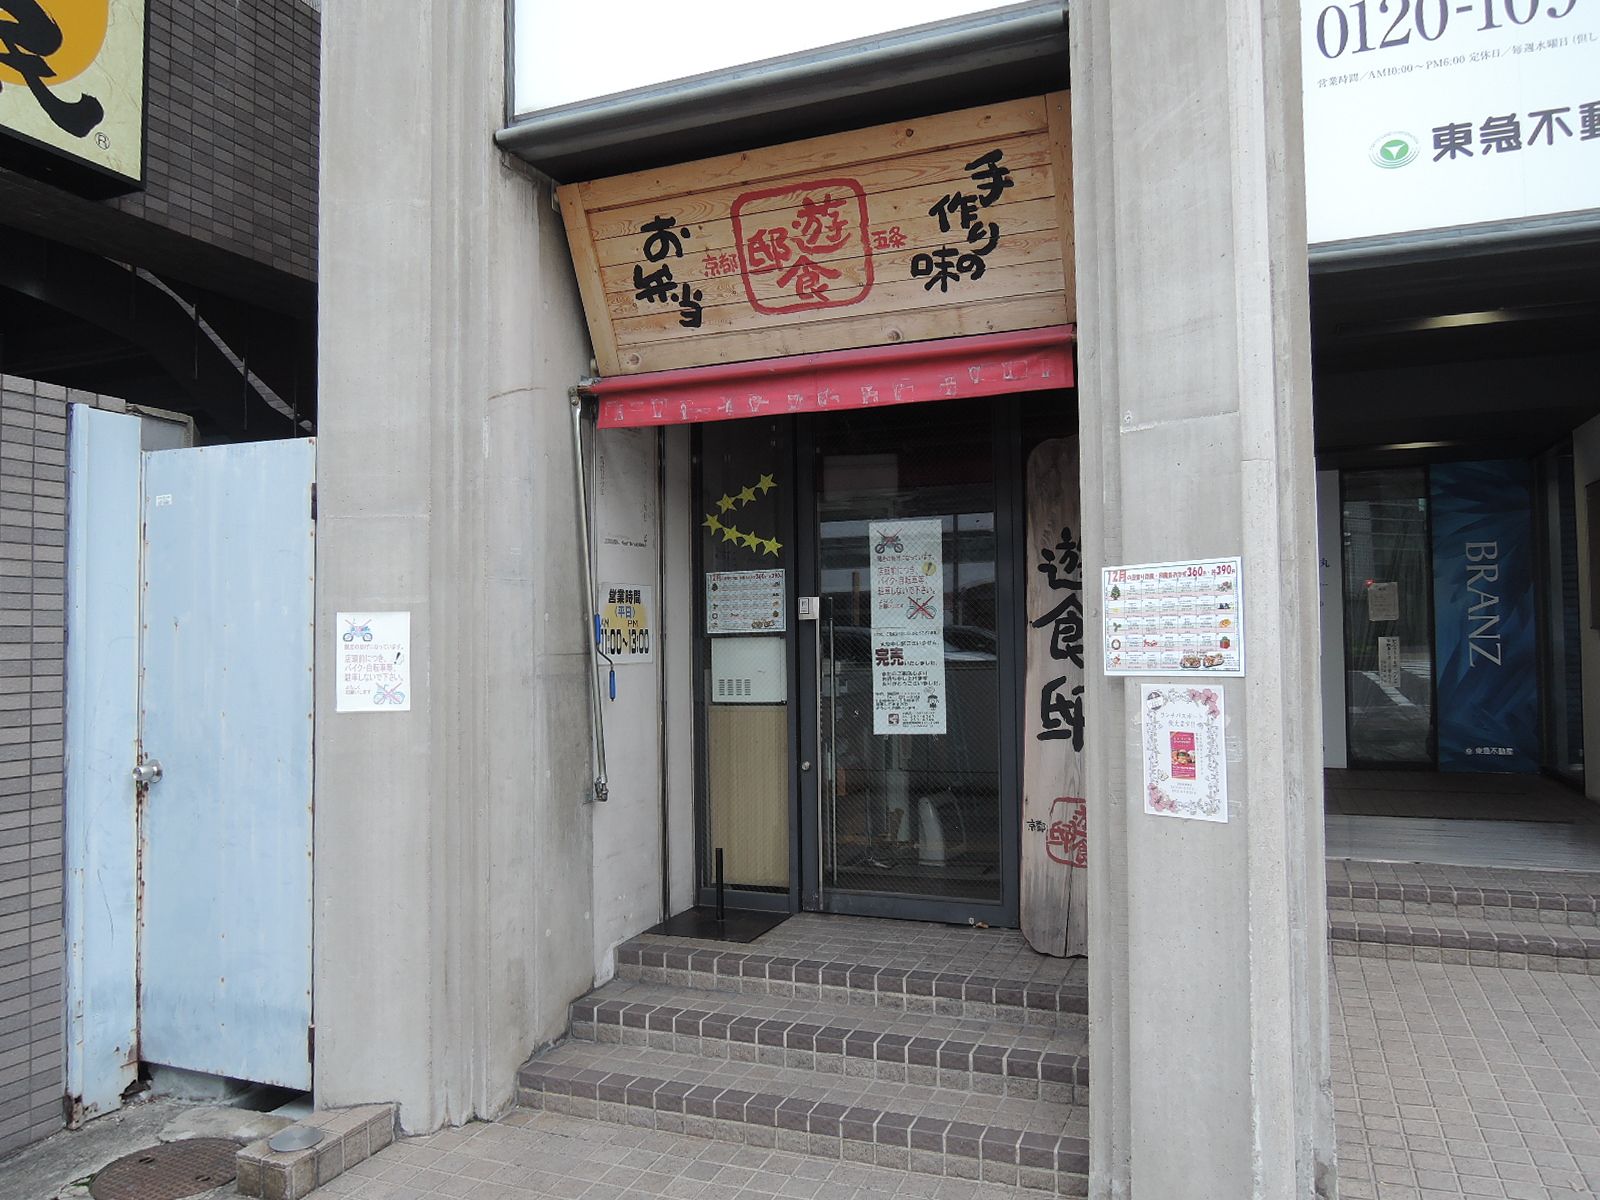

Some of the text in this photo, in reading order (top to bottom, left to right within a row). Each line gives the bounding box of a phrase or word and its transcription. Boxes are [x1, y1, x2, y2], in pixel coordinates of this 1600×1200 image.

[701, 251, 739, 276] 京都
[608, 588, 641, 604] 営業時間
[1464, 541, 1502, 668] BRANZ
[627, 619, 639, 628] PM
